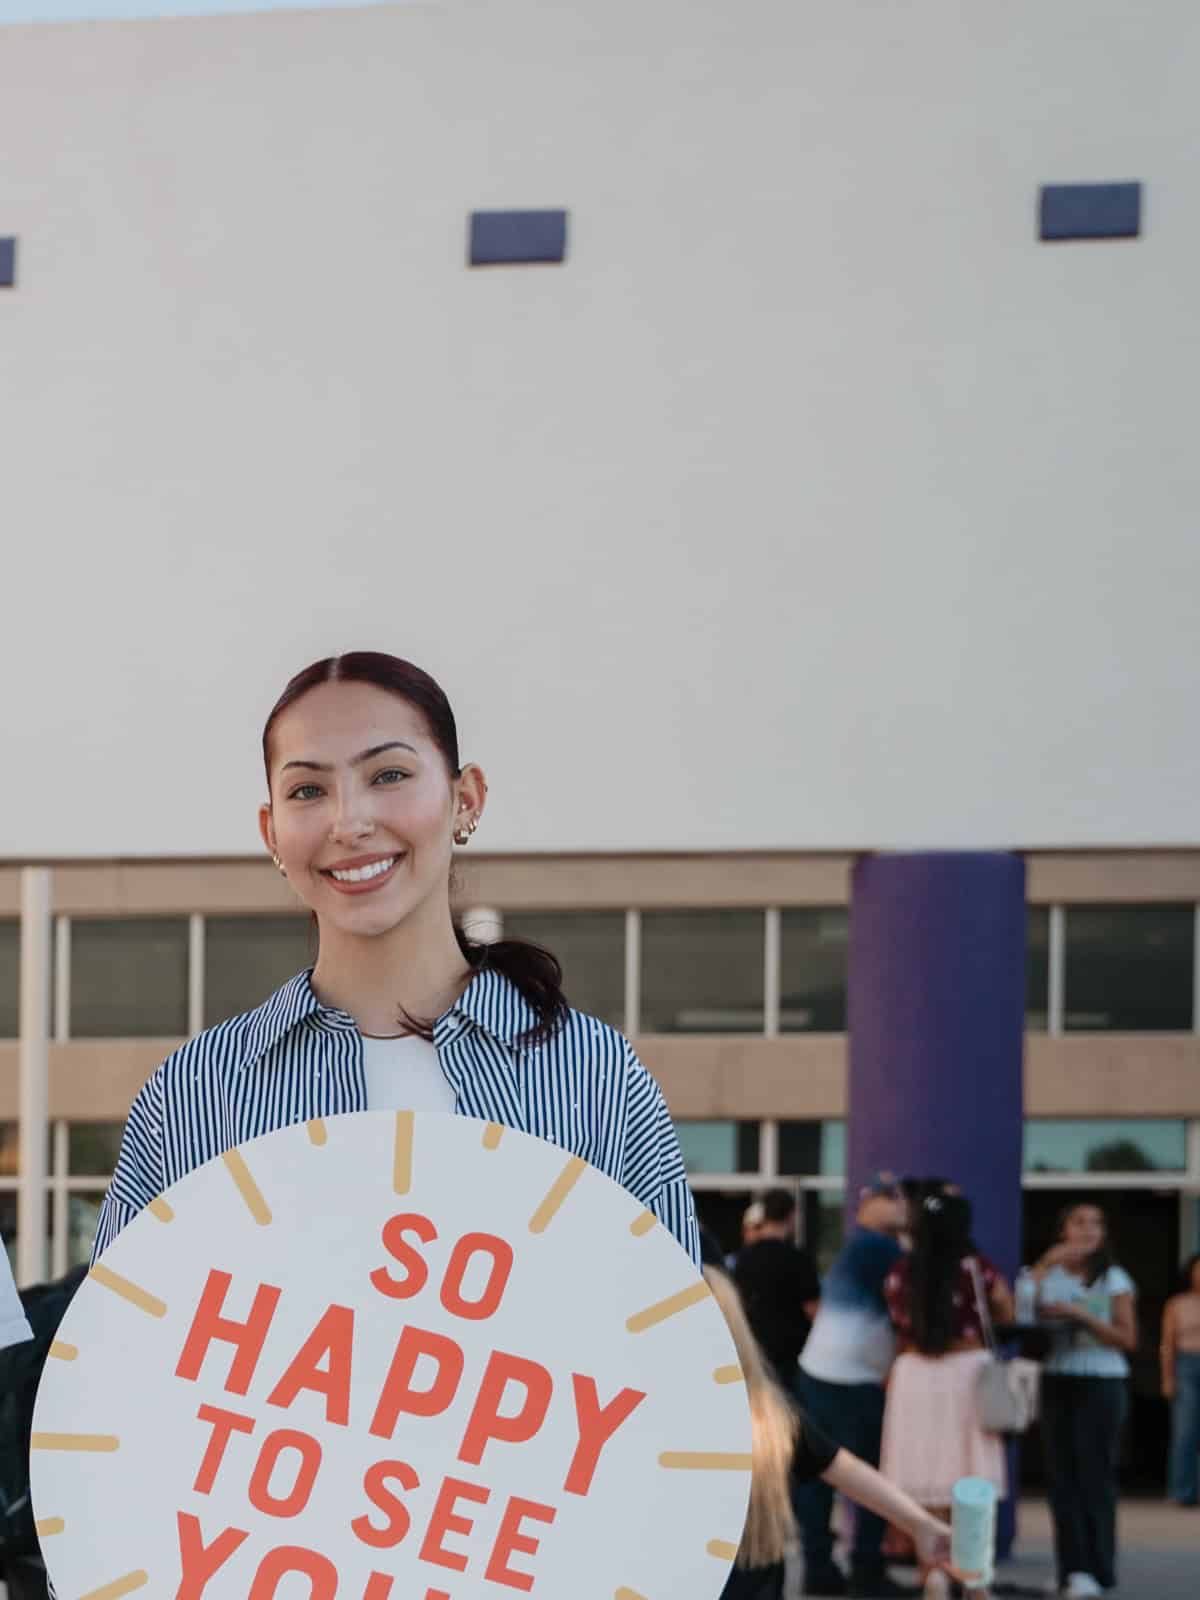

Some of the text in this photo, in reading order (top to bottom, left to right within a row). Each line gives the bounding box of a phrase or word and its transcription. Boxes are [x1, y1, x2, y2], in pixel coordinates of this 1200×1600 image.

[370, 1213, 514, 1321] SO
[174, 1269, 647, 1497] HAPPY
[193, 1404, 557, 1592] TO SEE
